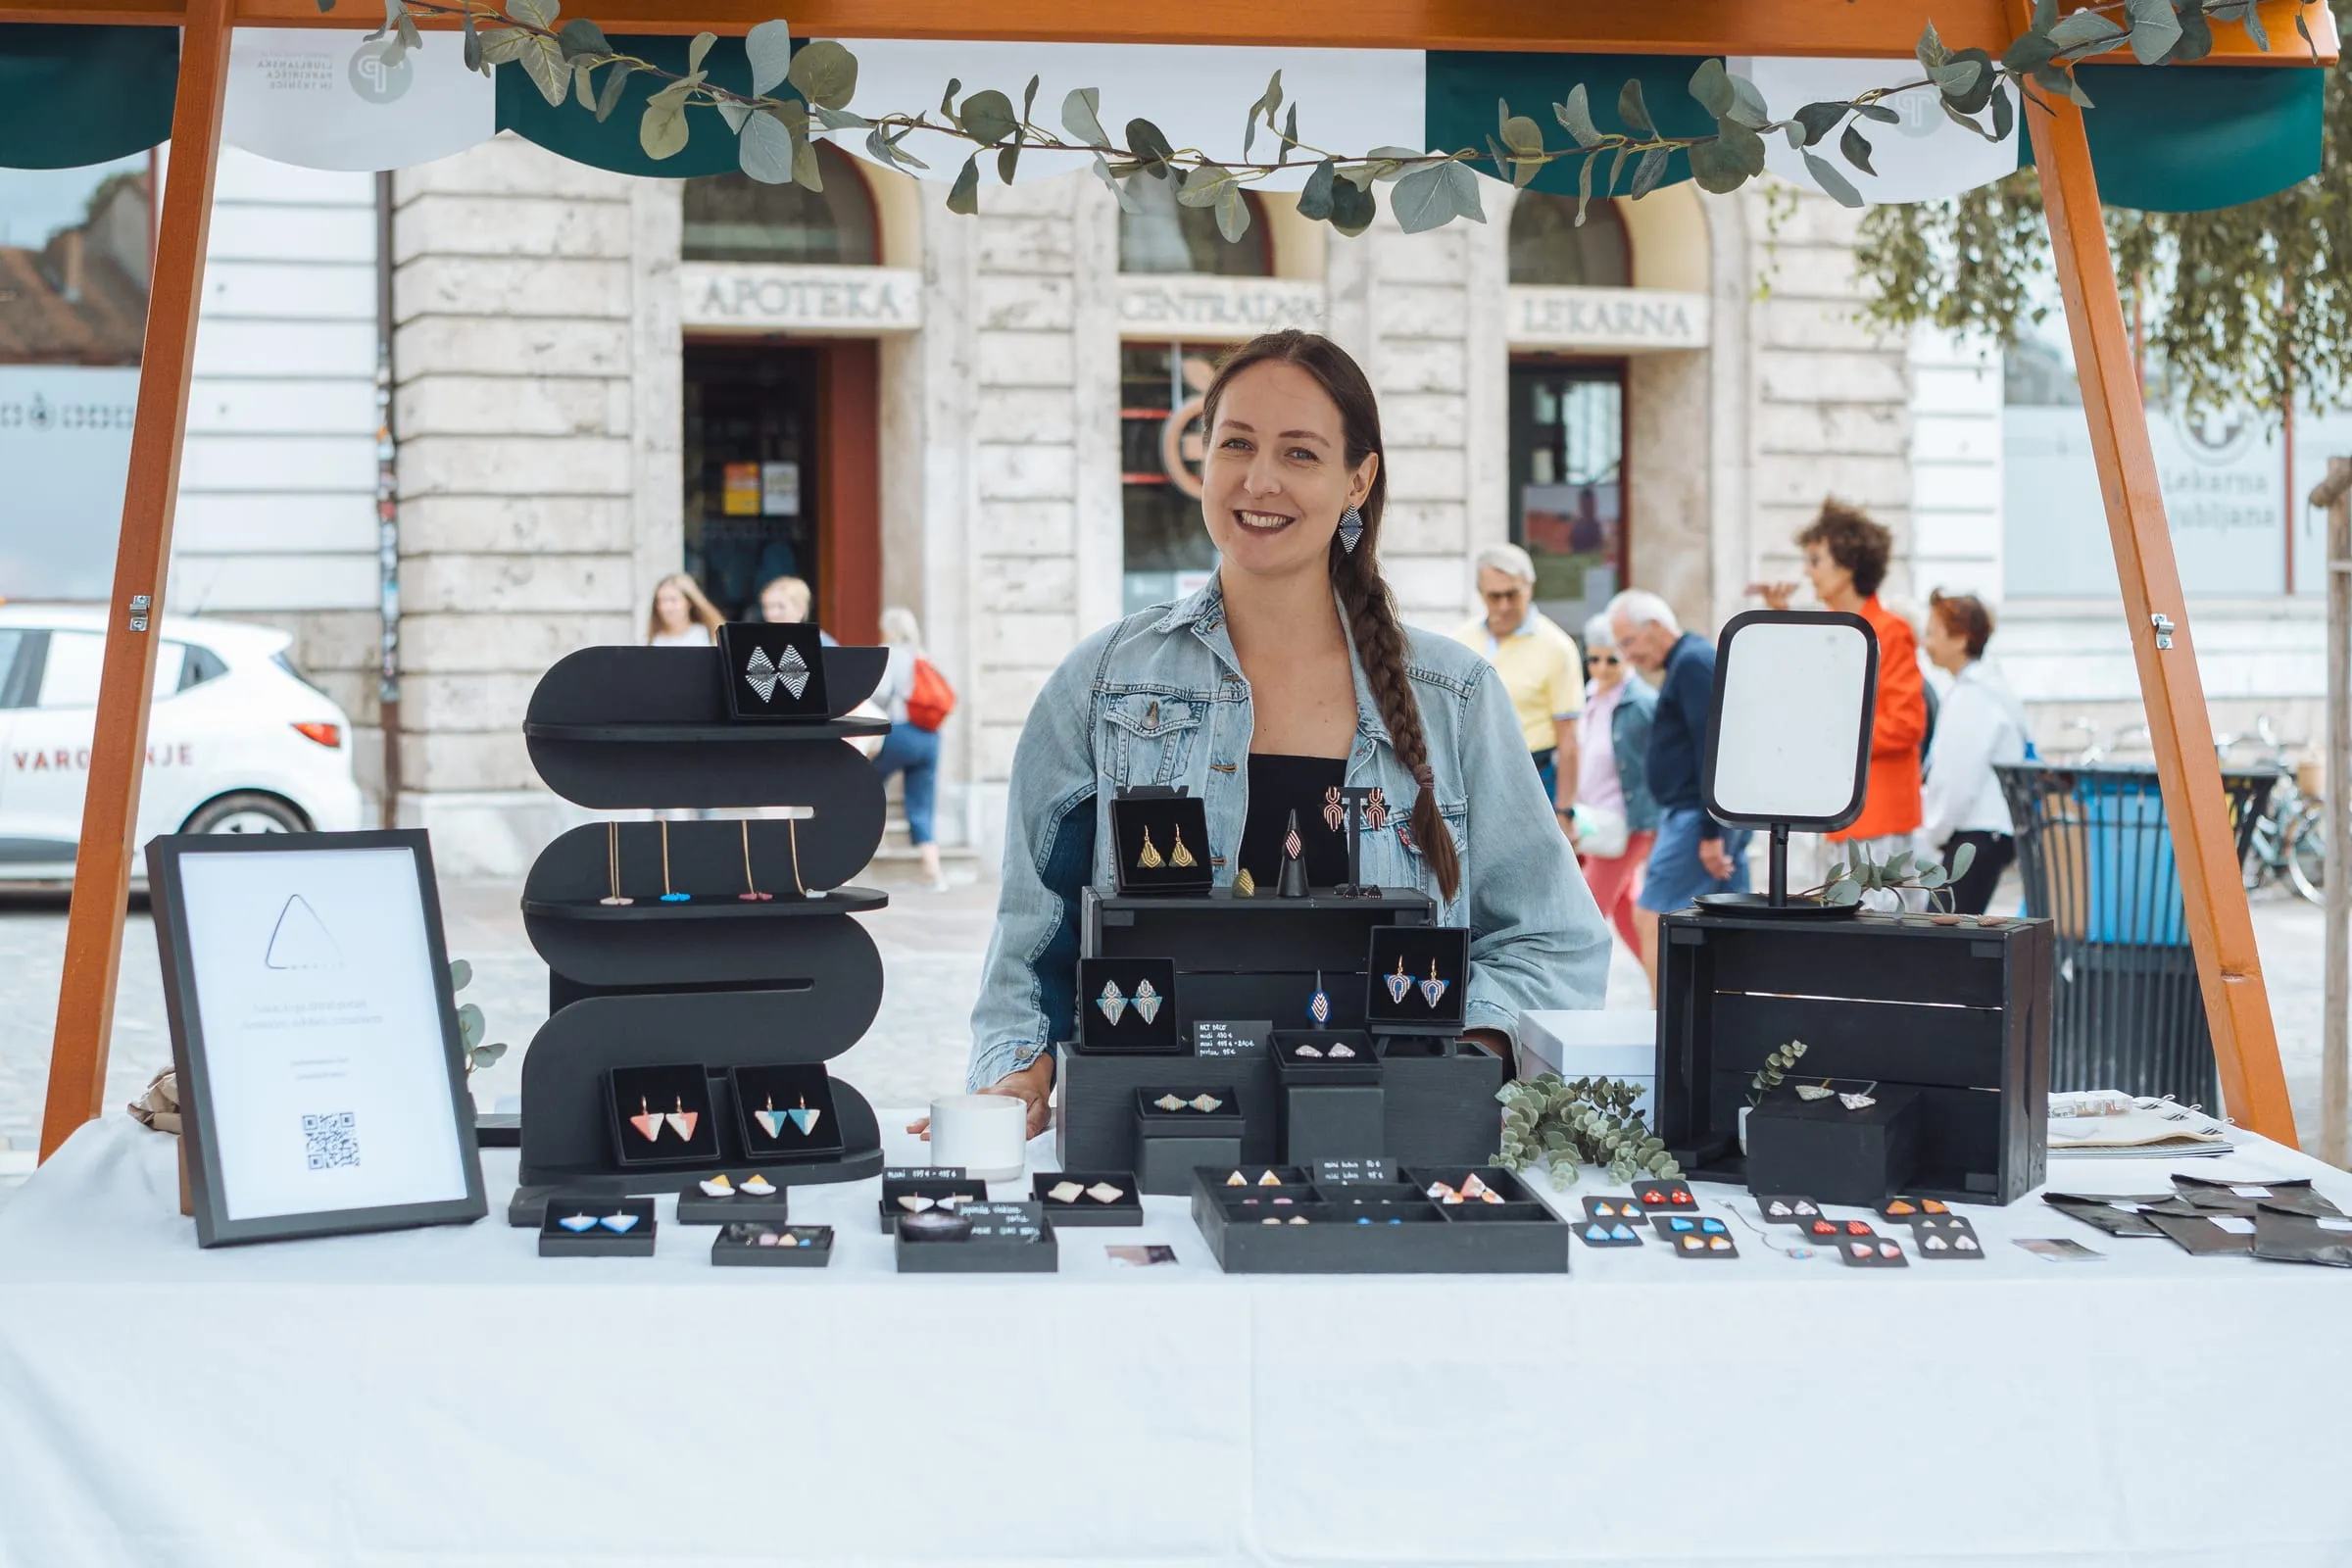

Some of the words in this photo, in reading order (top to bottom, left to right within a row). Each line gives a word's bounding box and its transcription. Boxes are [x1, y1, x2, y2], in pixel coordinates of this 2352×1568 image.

[701, 277, 901, 318] APOTEKA
[1524, 298, 1690, 337] LEKARNA
[2163, 468, 2268, 494] Lekarna
[2169, 501, 2276, 534] jubljana
[13, 744, 193, 771] VAROJE
